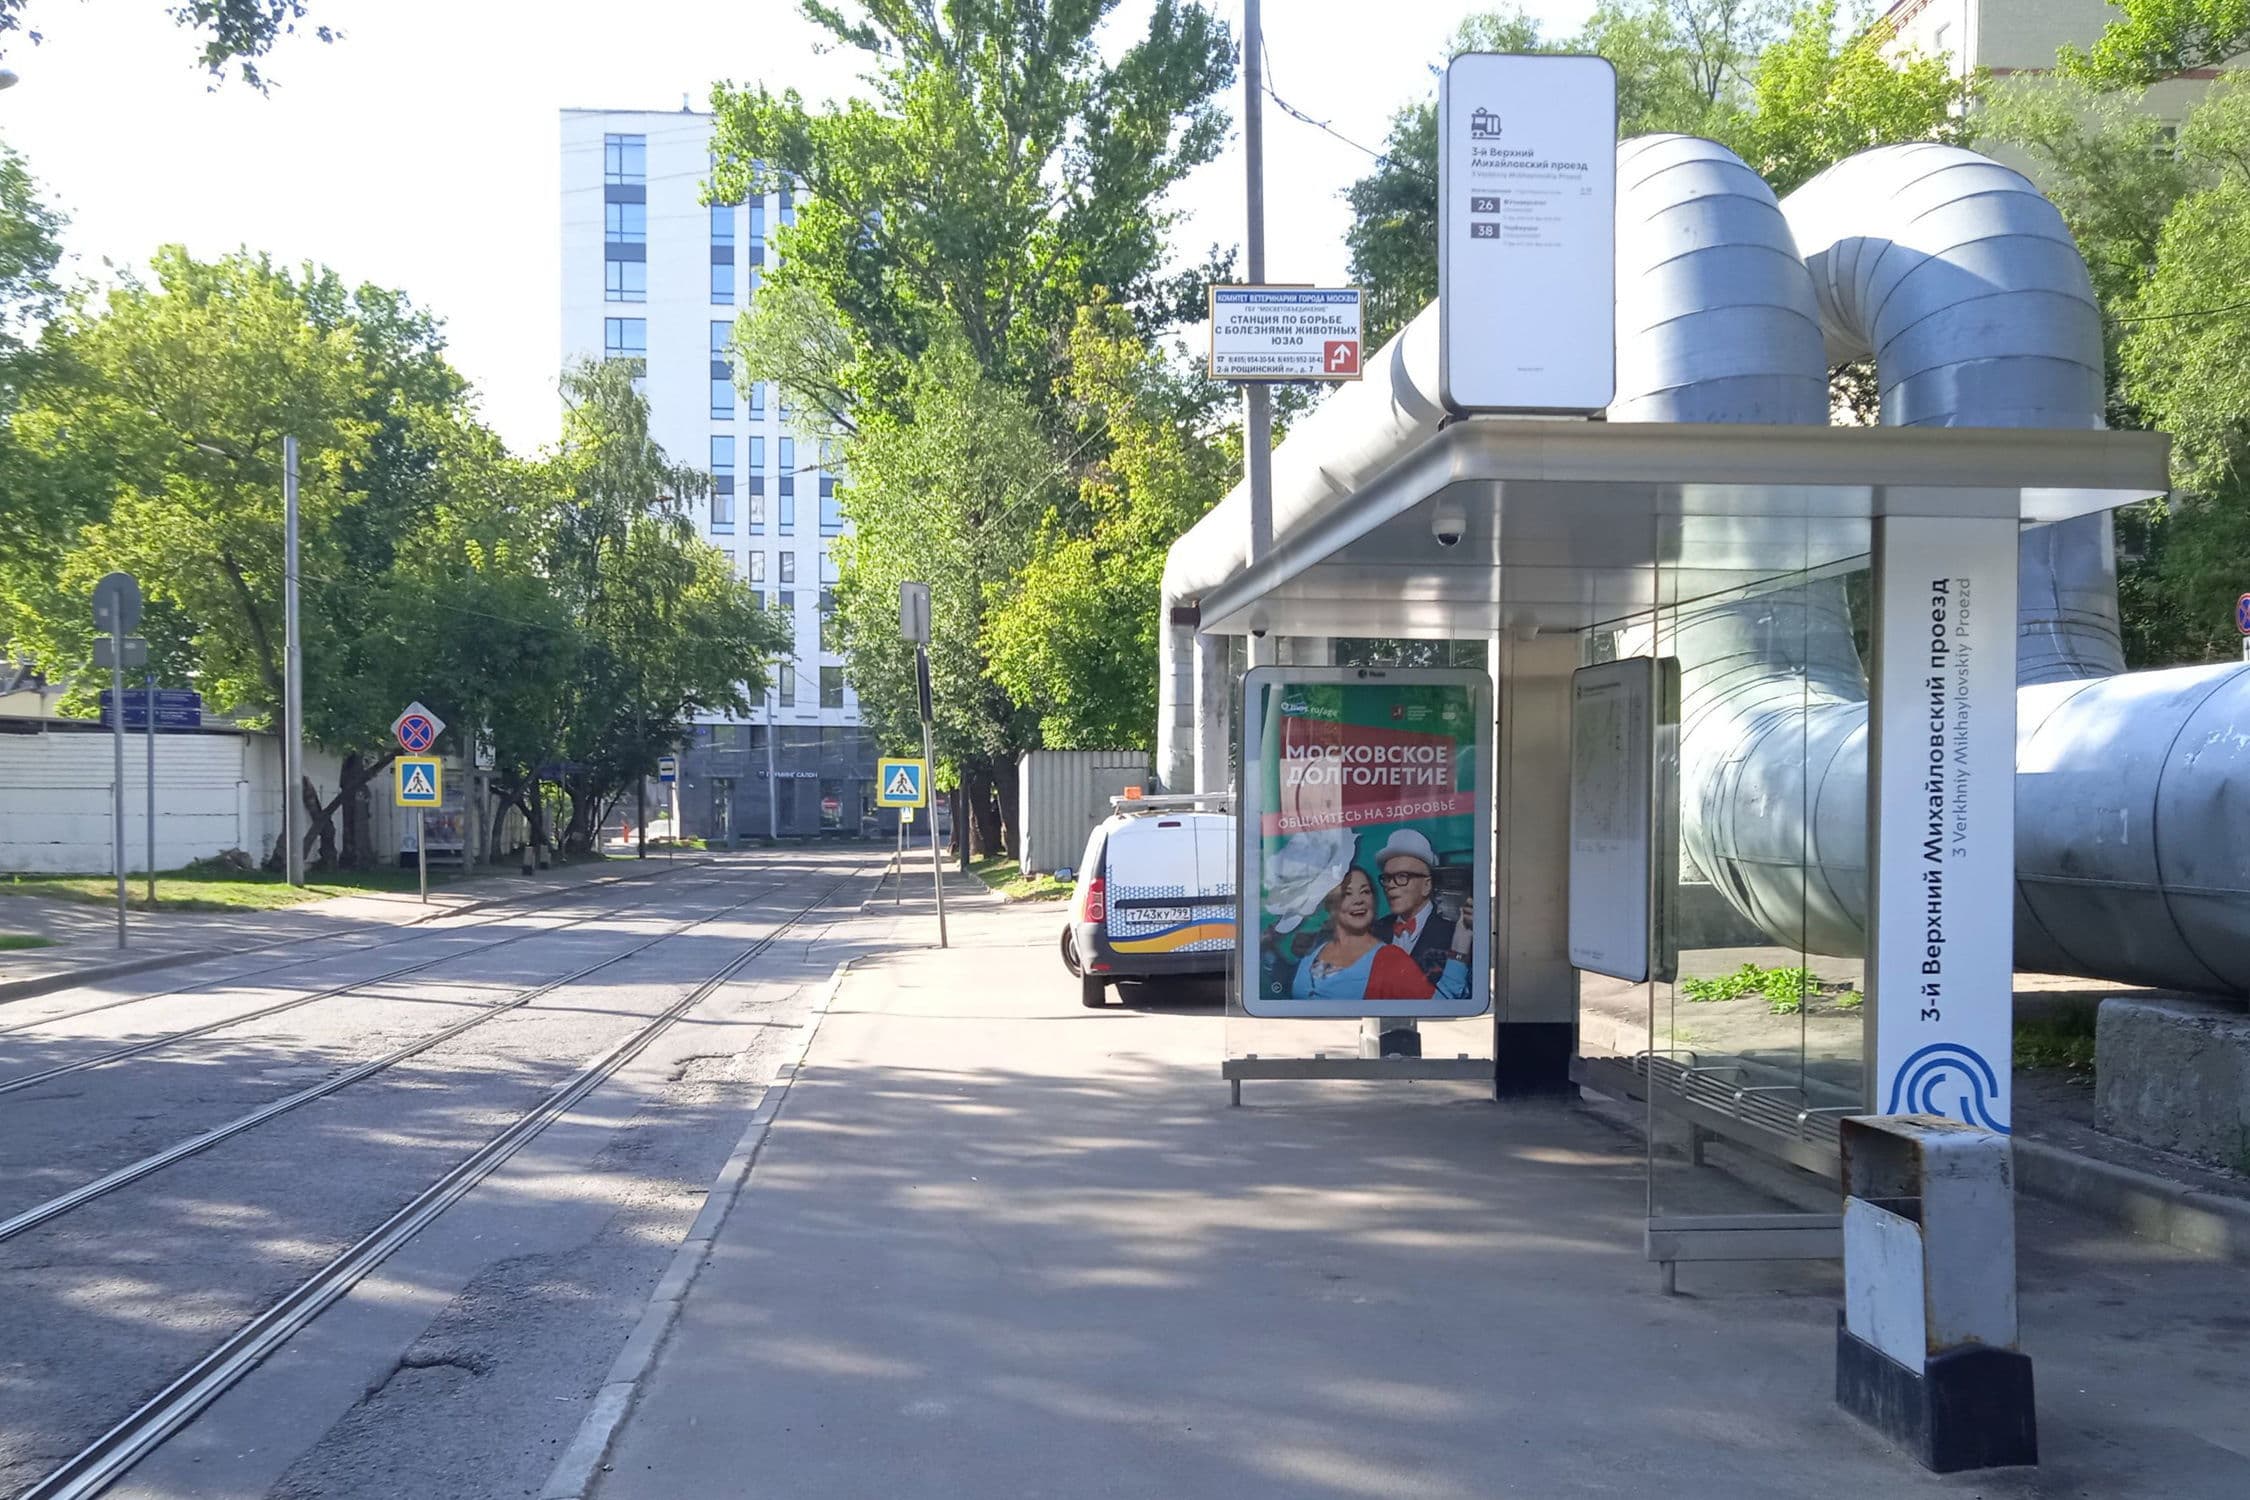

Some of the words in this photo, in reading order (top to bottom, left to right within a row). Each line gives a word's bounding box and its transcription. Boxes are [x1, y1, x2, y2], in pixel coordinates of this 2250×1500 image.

[1471, 146, 1487, 156] 3-й
[1489, 147, 1534, 158] Верхний
[1471, 158, 1549, 169] Михайловский
[1550, 160, 1588, 171] проезд
[1477, 200, 1494, 211] 26
[1477, 225, 1494, 236] 38
[1218, 294, 1248, 302] КОМИТЕТ
[1249, 294, 1297, 303] ВЕТЕРИНАРИИ
[1299, 295, 1325, 303] ГОРОДА
[1326, 295, 1358, 303] МОСКВЫ
[1230, 315, 1279, 325] СТАНЦИЯ
[1282, 316, 1297, 324] ПО
[1300, 316, 1342, 325] БОРЬБЕ
[1215, 326, 1222, 335] С
[1224, 326, 1293, 335] БОЛЕЗНЯМИ
[1295, 326, 1357, 335] ЖИВОТНЫХ
[1271, 337, 1304, 346] ЮЗАО
[1216, 365, 1229, 373] 2-й
[1231, 364, 1284, 374] РОЩИНСКИЙ
[1955, 577, 1971, 637] Proezd
[1930, 578, 1950, 669] проезд
[1953, 642, 1973, 766] Mikhaylovskiy
[1286, 744, 1448, 764] МОСКОВСКОЕ
[1286, 766, 1448, 787] ДОЛГОЛЕТИЕ
[1924, 676, 1947, 864] Михайловский
[1952, 767, 1971, 843] Verkhniy
[1278, 809, 1361, 830] ОБЩАЙТЕСЬ
[1363, 807, 1382, 822] НА
[1385, 799, 1456, 818] ЗДОРОВЬЕ
[1952, 847, 1967, 858] 3
[1170, 908, 1188, 917] 799
[1922, 870, 1946, 975] Верхний
[1921, 982, 1942, 1022] 3-й
